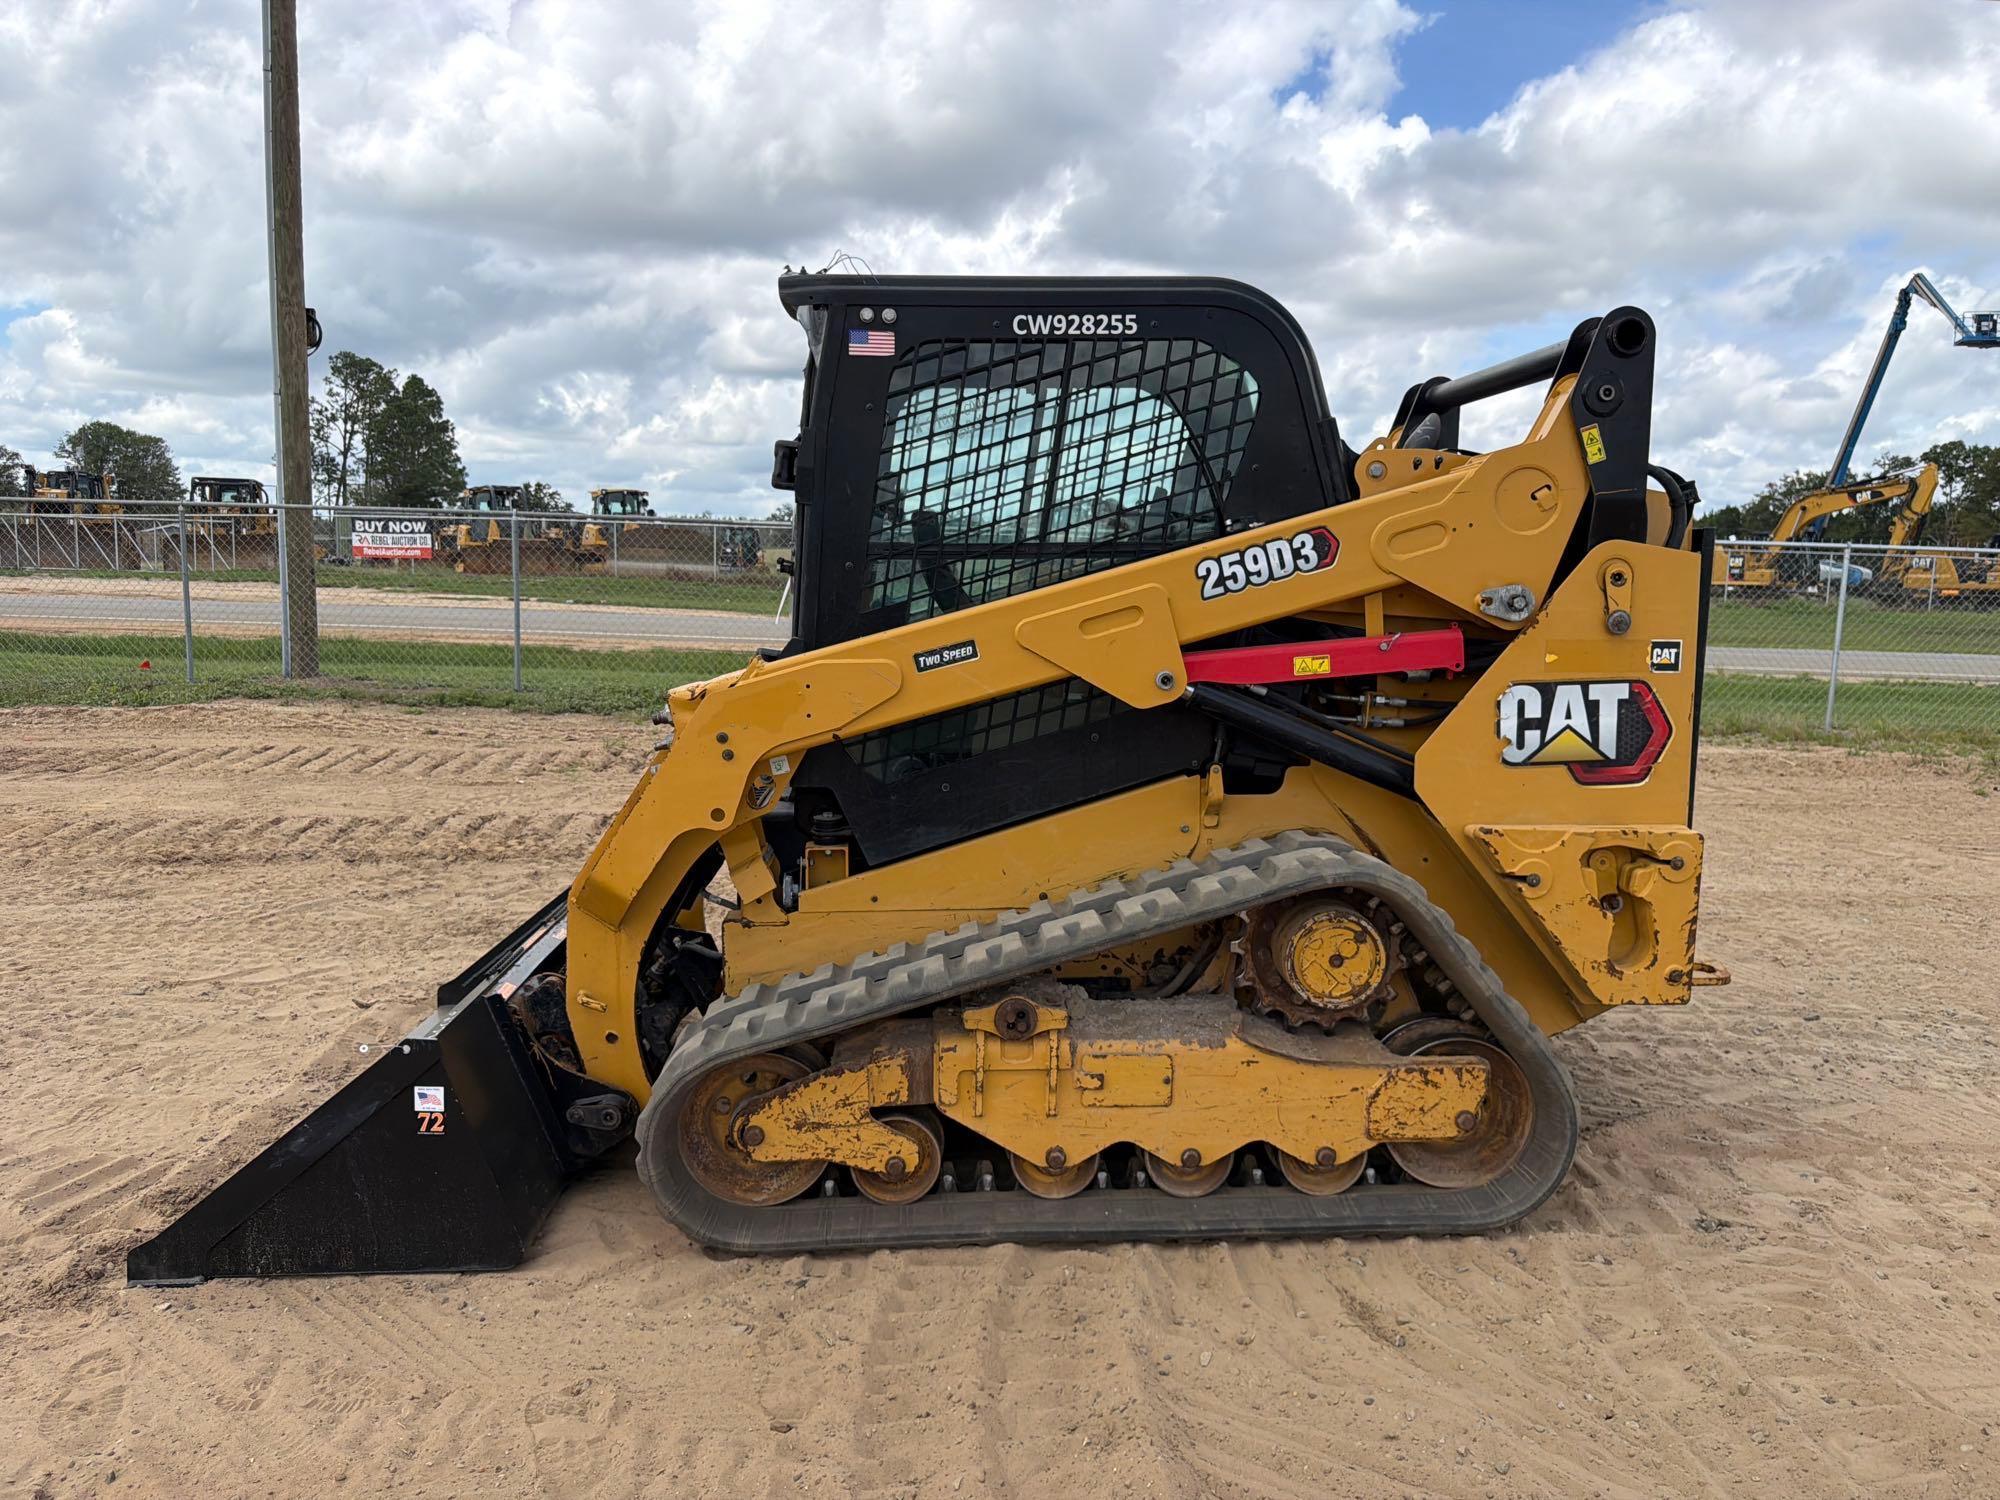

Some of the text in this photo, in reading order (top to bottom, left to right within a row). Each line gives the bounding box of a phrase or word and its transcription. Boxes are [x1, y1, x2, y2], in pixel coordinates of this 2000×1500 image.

[1012, 314, 1138, 335] CW928255
[1856, 490, 1871, 503] CAT
[355, 520, 426, 533] BUY NOW
[371, 535, 389, 546] REBEL
[391, 535, 417, 546] AUCTION
[363, 547, 421, 556] RebelAuction.com
[1197, 532, 1319, 599] 259D3
[1729, 557, 1744, 568] CAT
[1912, 557, 1932, 569] CAT
[1652, 647, 1677, 664] CAT
[1500, 683, 1629, 764] CAT
[417, 1112, 445, 1132] 72
